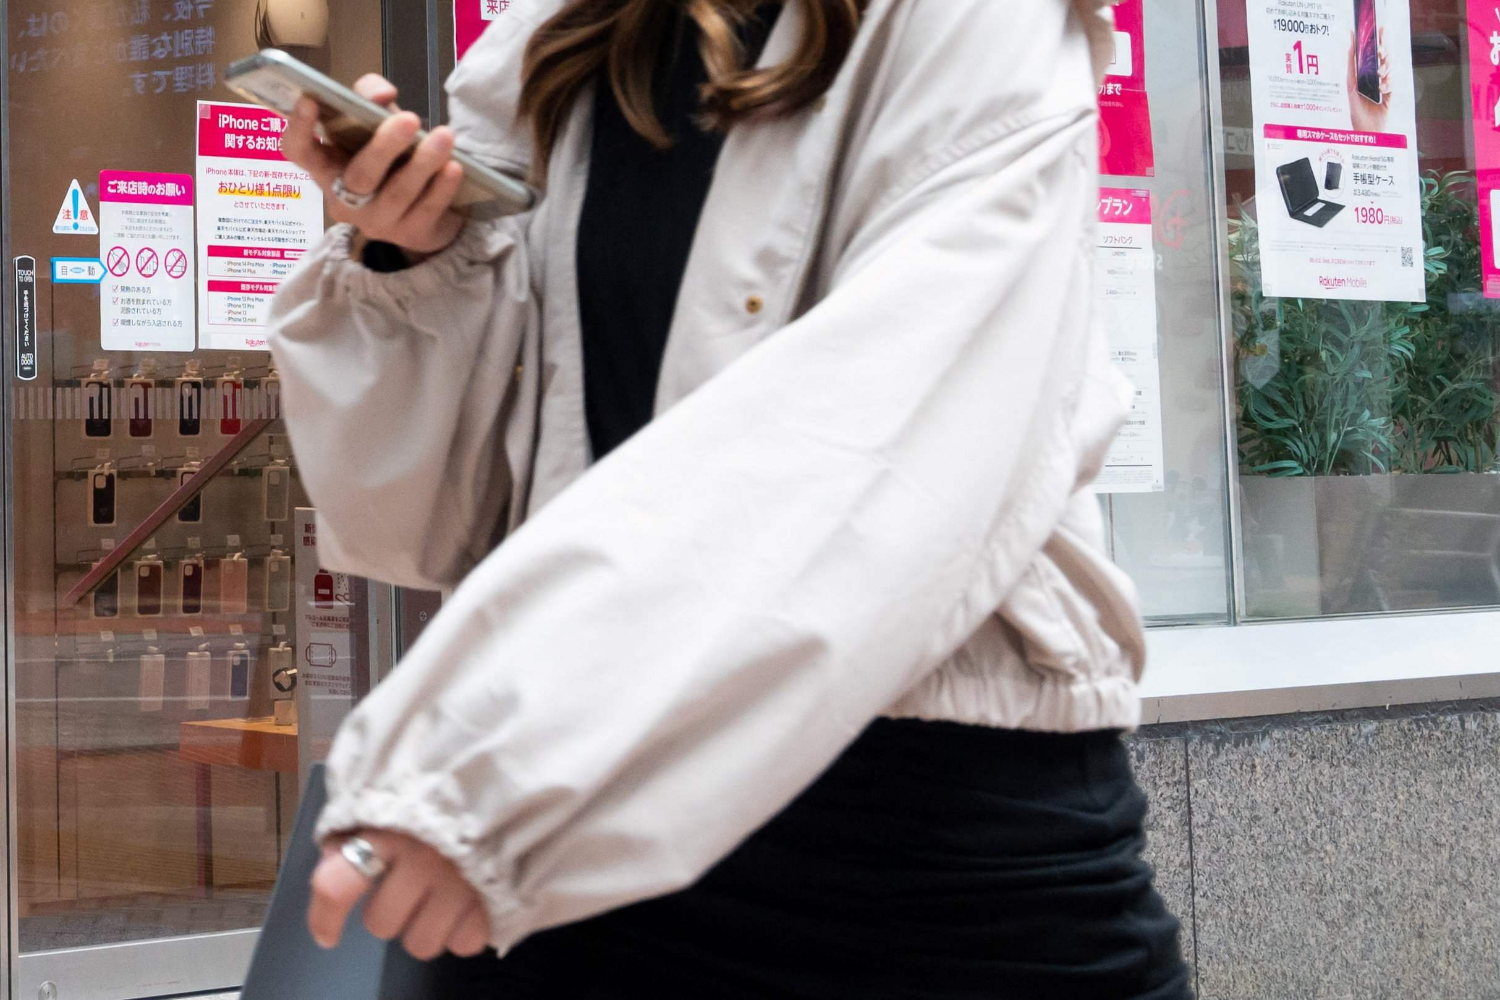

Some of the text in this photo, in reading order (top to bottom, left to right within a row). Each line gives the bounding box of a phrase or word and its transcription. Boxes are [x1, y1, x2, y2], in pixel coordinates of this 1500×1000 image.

[1292, 39, 1319, 75] 1円
[218, 113, 258, 131] iPhone
[1352, 172, 1396, 187] 手帳型ケース
[107, 179, 186, 197] ご来店時のお願い
[217, 181, 302, 199] おひとり様1点限り
[233, 200, 290, 211] とさせていただきます。
[62, 209, 89, 221] 注意
[17, 269, 34, 277] TOUCH
[1318, 275, 1368, 290] Rakuten Mobile
[20, 358, 34, 366] DOOR
